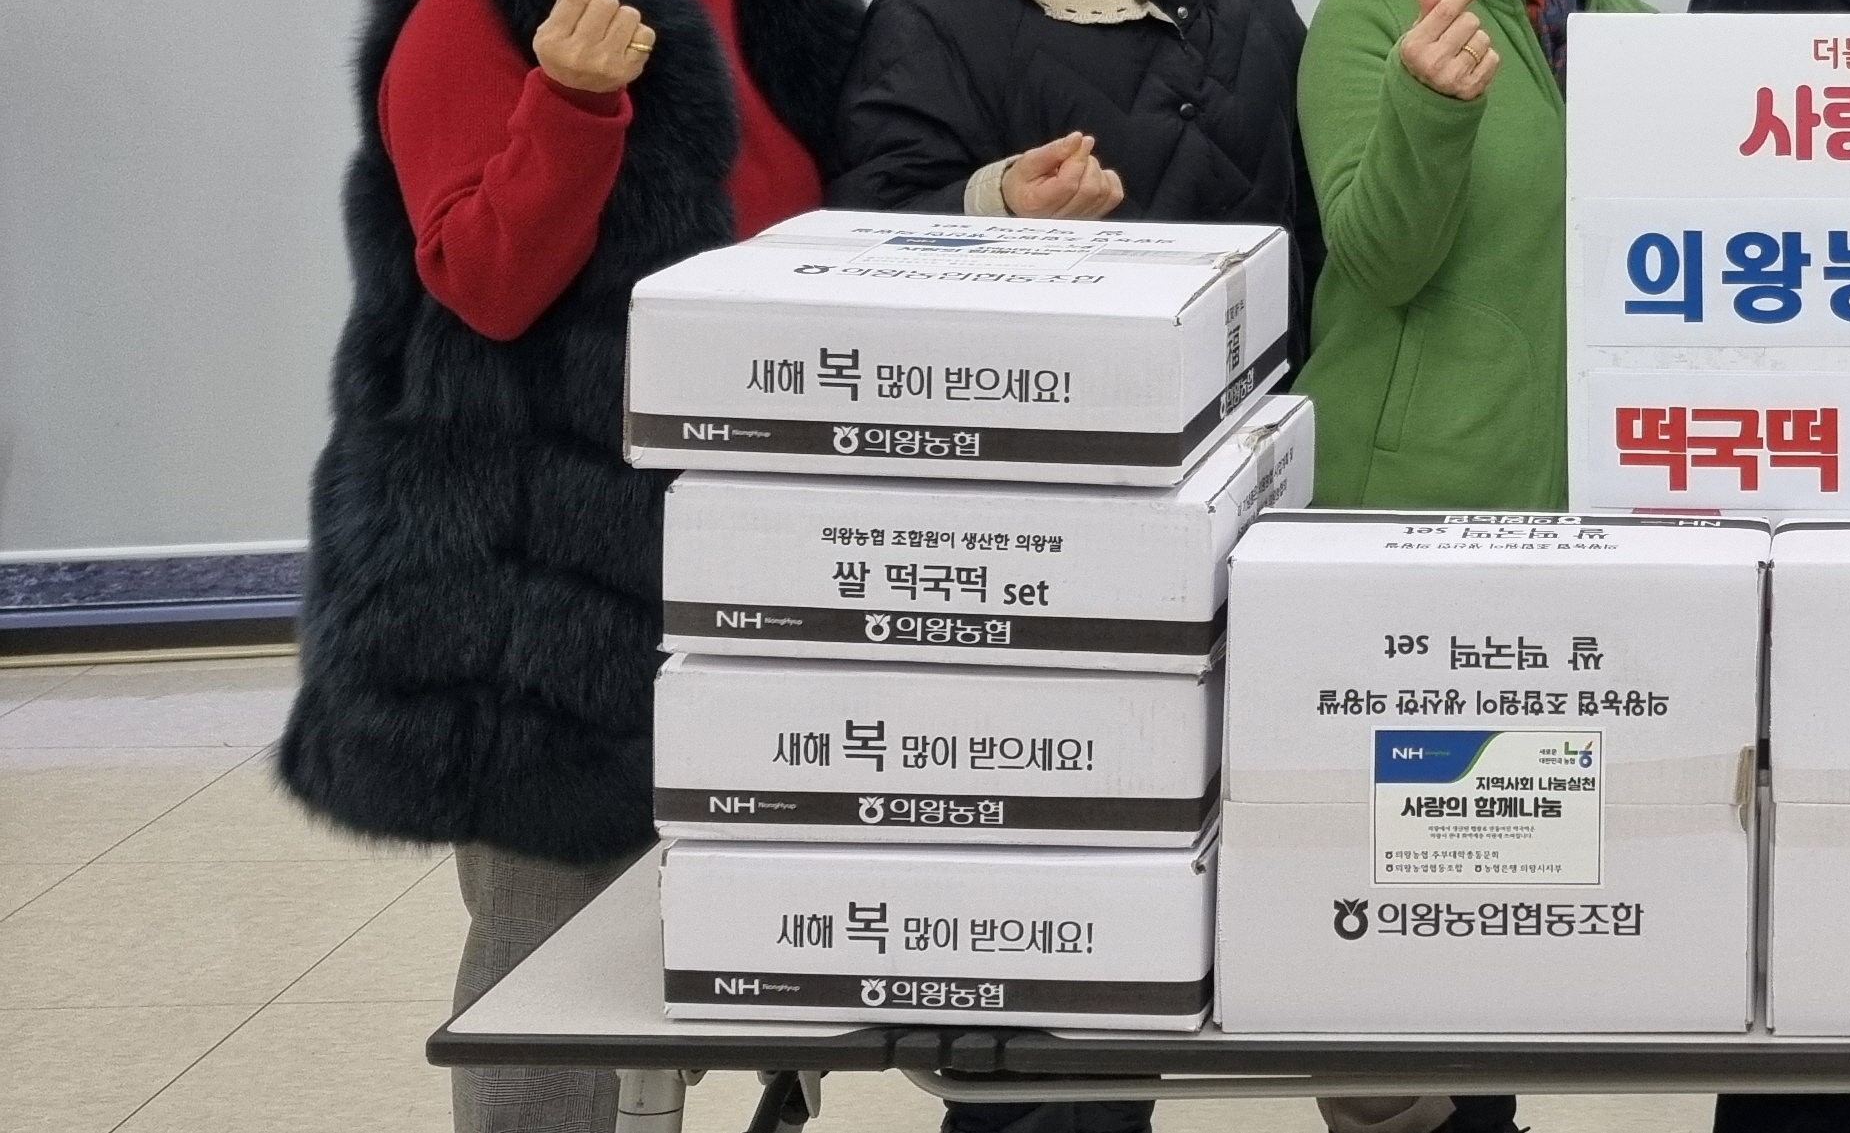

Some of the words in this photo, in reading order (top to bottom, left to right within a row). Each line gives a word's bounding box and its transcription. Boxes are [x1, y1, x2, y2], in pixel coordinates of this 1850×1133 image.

[747, 360, 804, 394] 새해
[817, 348, 861, 401] 복
[877, 365, 932, 399] 많이
[945, 367, 1070, 403] 받으세요!
[1226, 367, 1254, 409] 의왕농협
[683, 423, 729, 440] NH
[865, 429, 979, 456] 의왕농협
[1613, 402, 1843, 495] 떡국떡
[821, 527, 884, 546] 의왕농협
[891, 530, 955, 549] 조합원이
[961, 533, 1010, 550] 생산한
[1015, 535, 1063, 553] 의왕쌀
[832, 562, 870, 598] 쌀
[885, 564, 987, 603] 떡국떡
[1003, 581, 1049, 606] set
[717, 611, 761, 628] NH
[897, 617, 1010, 644] 의왕농협
[1385, 635, 1429, 658] set
[1451, 636, 1549, 670] 떡국떡
[1568, 637, 1604, 670] 쌀
[1317, 689, 1387, 715] 의왕쌀
[1396, 689, 1466, 715] 생산한
[1477, 691, 1568, 715] 조합원이
[1579, 690, 1669, 716] 의왕농협
[773, 732, 830, 766] 새해
[843, 720, 887, 772] 복
[902, 736, 956, 769] 많이
[970, 737, 1093, 771] 받으세요!
[1393, 748, 1423, 759] NH
[1476, 777, 1533, 790] 지역사회
[1539, 777, 1595, 791] 나눔실천
[710, 797, 754, 813] NH
[890, 799, 1003, 824] 의왕농협
[1401, 797, 1467, 817] 사랑의
[1474, 797, 1562, 817] 함께나눔
[777, 914, 833, 948] 새해
[846, 902, 889, 954] 복
[904, 917, 958, 951] 많이
[971, 919, 1093, 954] 받으세요!
[1378, 902, 1644, 937] 의왕농업협동조합
[715, 978, 759, 995] NH
[892, 982, 1003, 1007] 의왕농협
